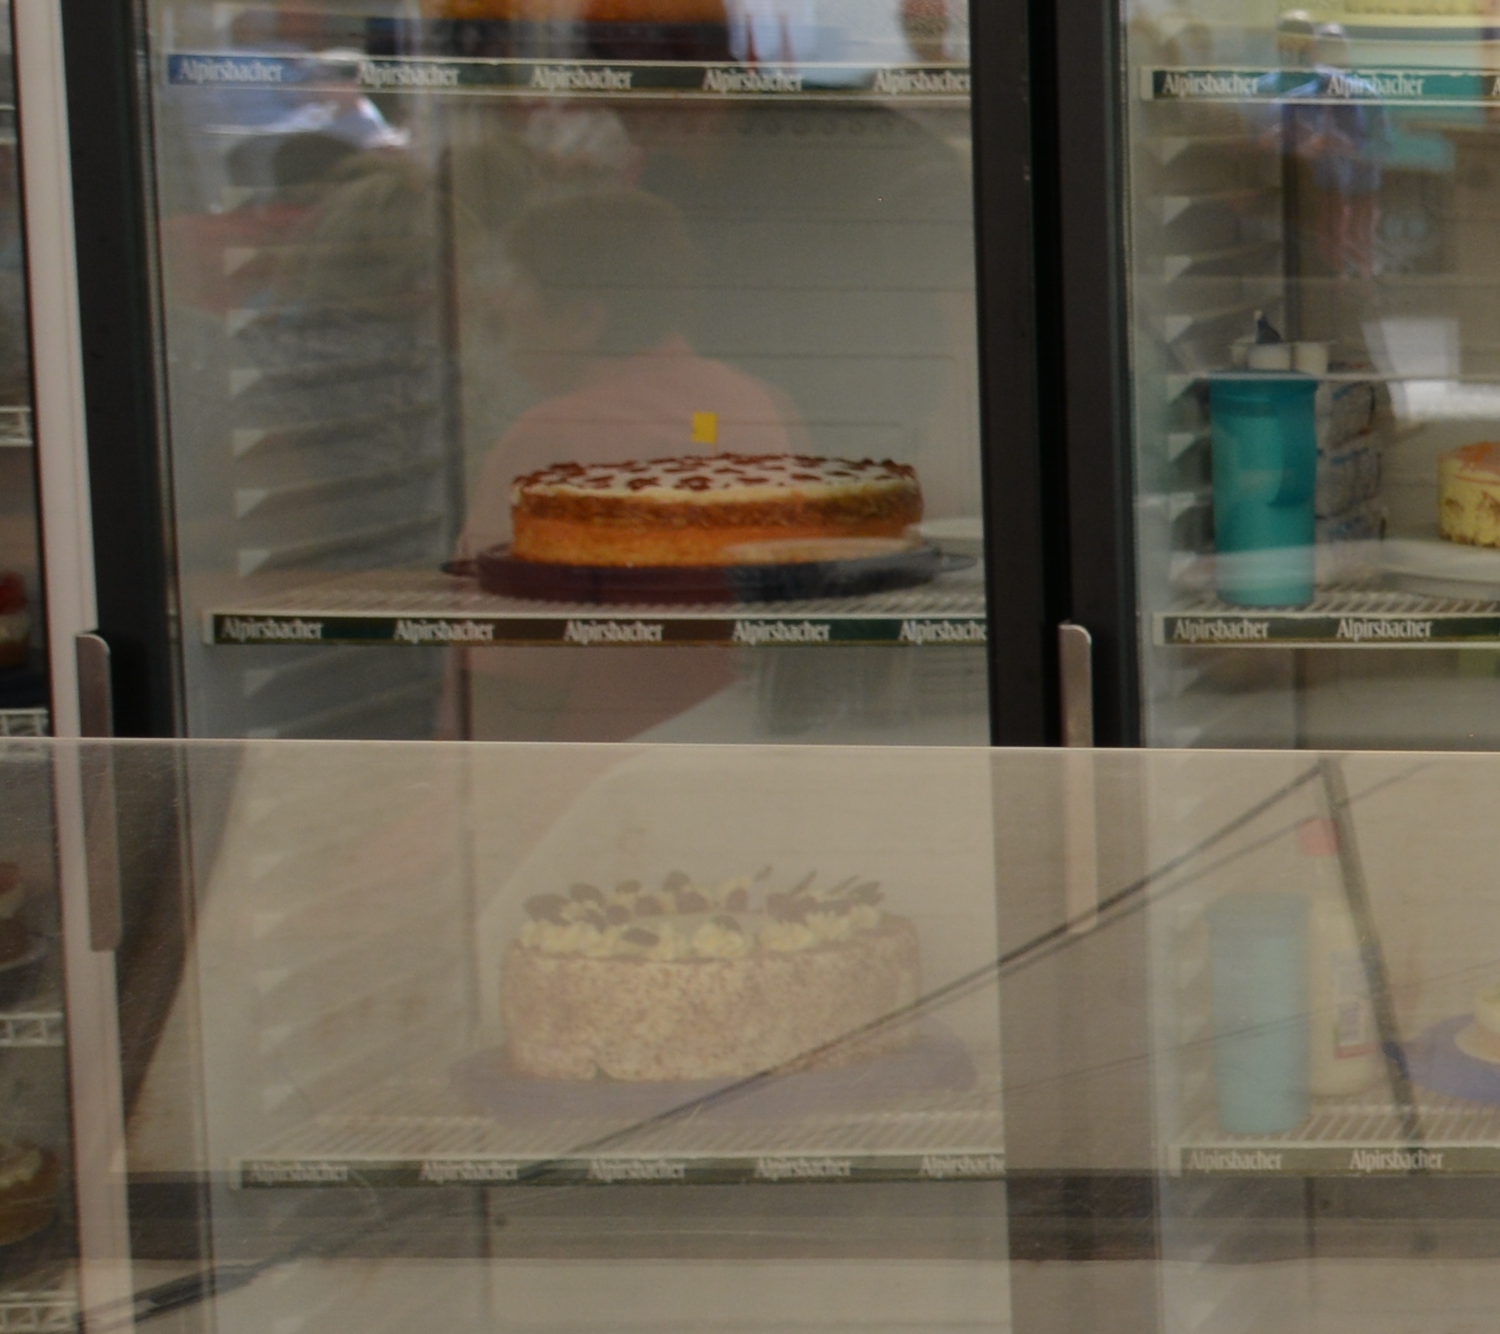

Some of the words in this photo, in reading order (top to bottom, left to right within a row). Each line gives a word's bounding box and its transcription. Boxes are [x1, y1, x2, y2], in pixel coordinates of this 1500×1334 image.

[179, 58, 282, 85] Alpirsbacher
[357, 61, 458, 88] Alpirsbacher
[530, 64, 632, 92] Alpirsbacher
[703, 67, 801, 94] Alpirsbacher
[1162, 73, 1258, 98] Alpirsbacher
[1327, 74, 1424, 99] Alpirsbacher
[221, 617, 324, 642] Alpirsbacher
[393, 619, 494, 644] Alpirsbacher
[564, 619, 662, 645] Alpirsbacher
[732, 619, 830, 645] Alpirsbacher
[1173, 618, 1268, 642] Alpirsbacher
[1336, 617, 1432, 641] Alpirsbacher
